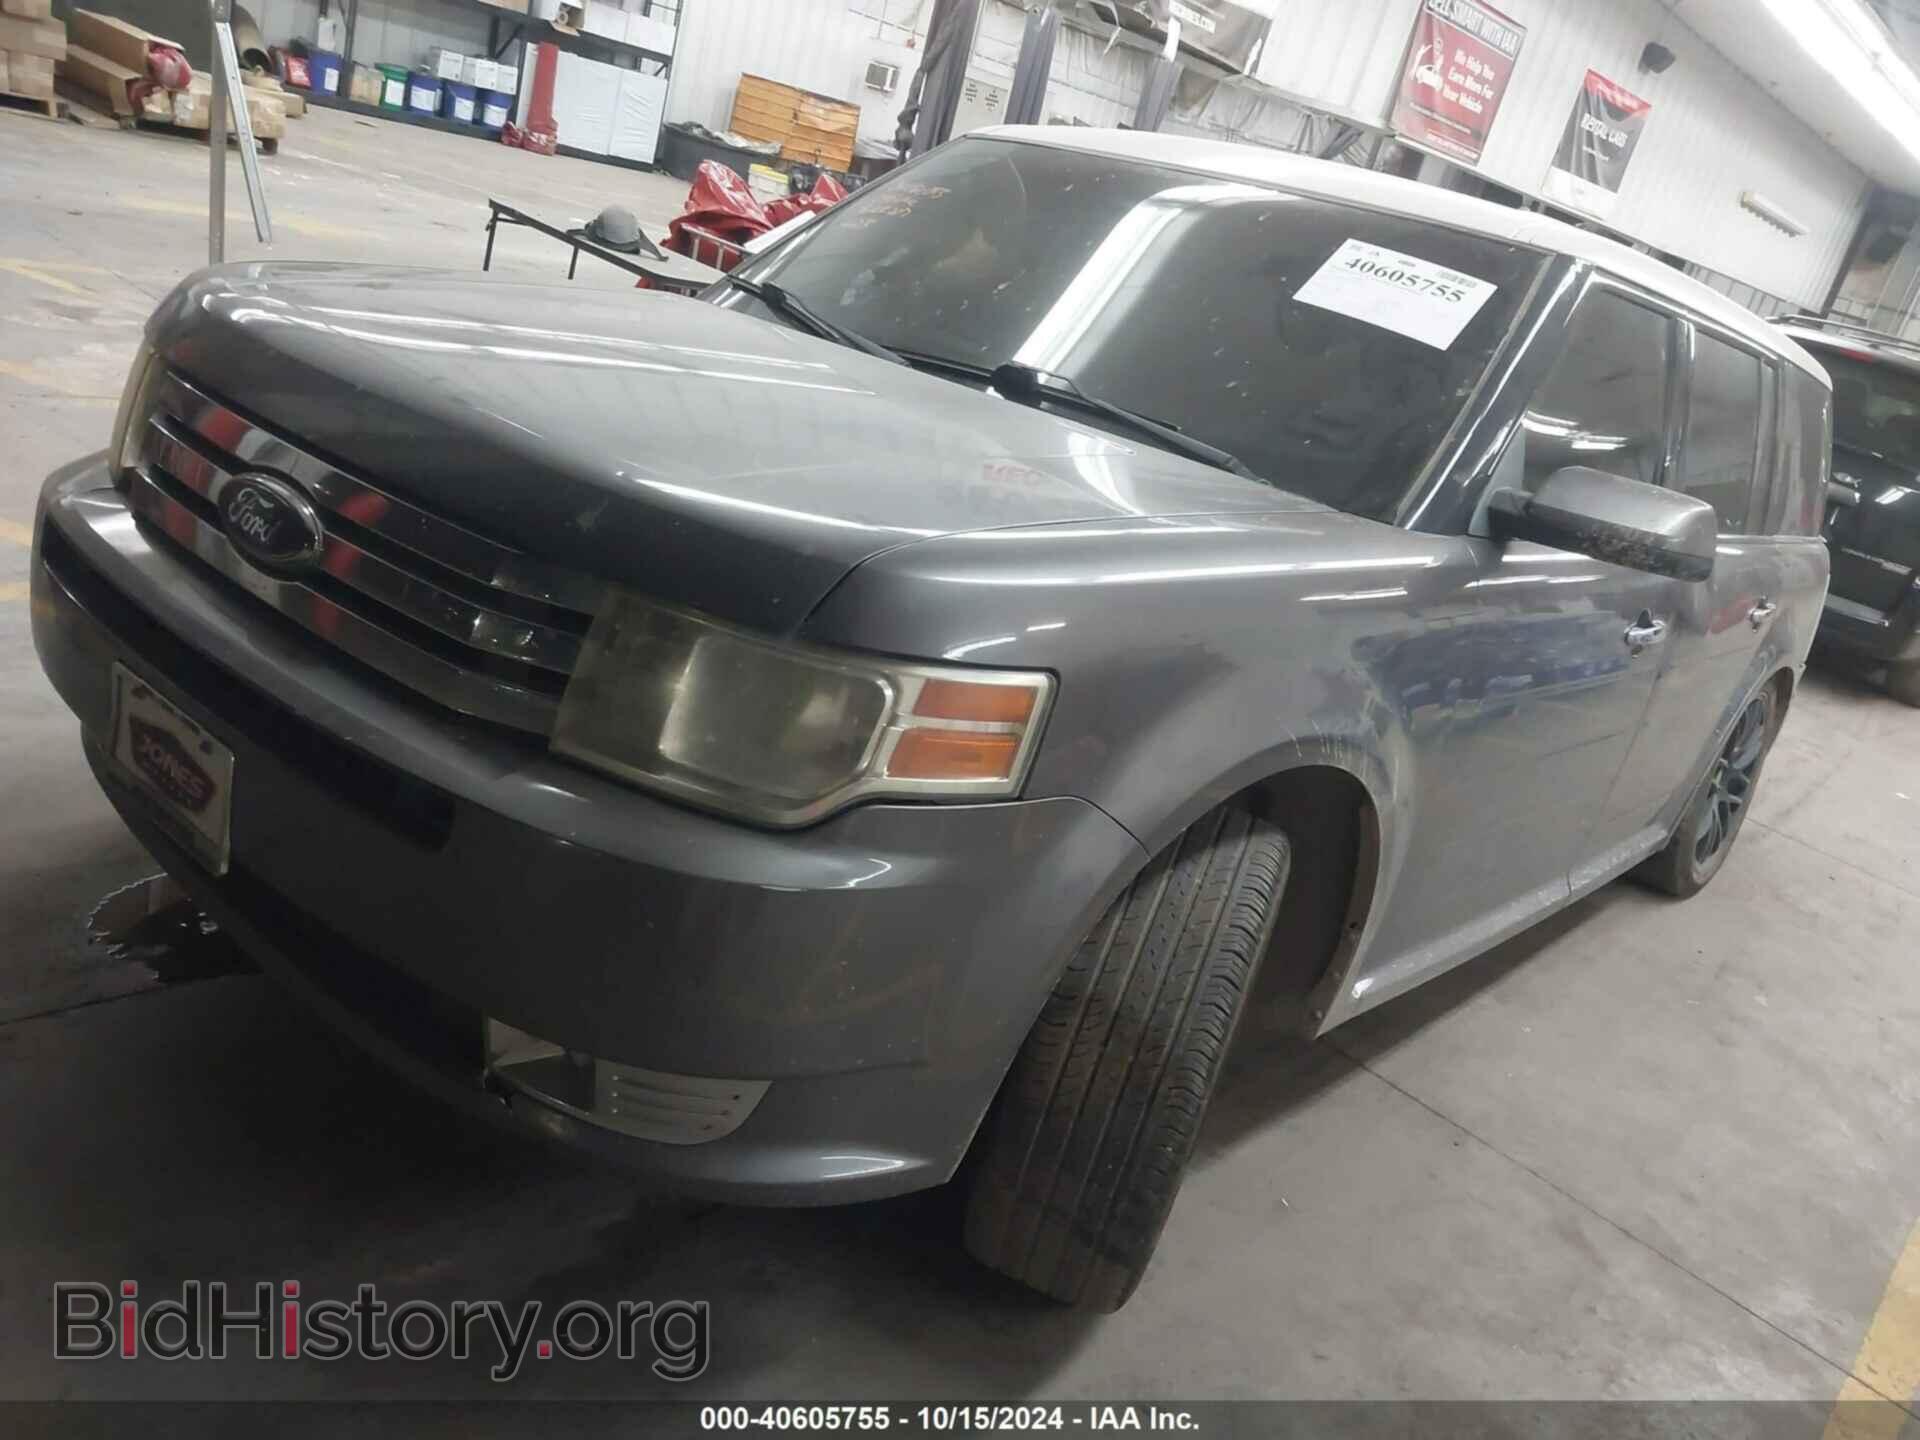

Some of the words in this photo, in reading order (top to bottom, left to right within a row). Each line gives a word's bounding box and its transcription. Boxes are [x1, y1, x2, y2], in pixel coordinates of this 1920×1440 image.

[1481, 16, 1505, 46] WITH
[1501, 27, 1520, 54] IAA
[1466, 55, 1483, 76] Help
[1482, 63, 1496, 81] You
[1345, 256, 1467, 303] 40605755
[228, 487, 282, 542] Ford
